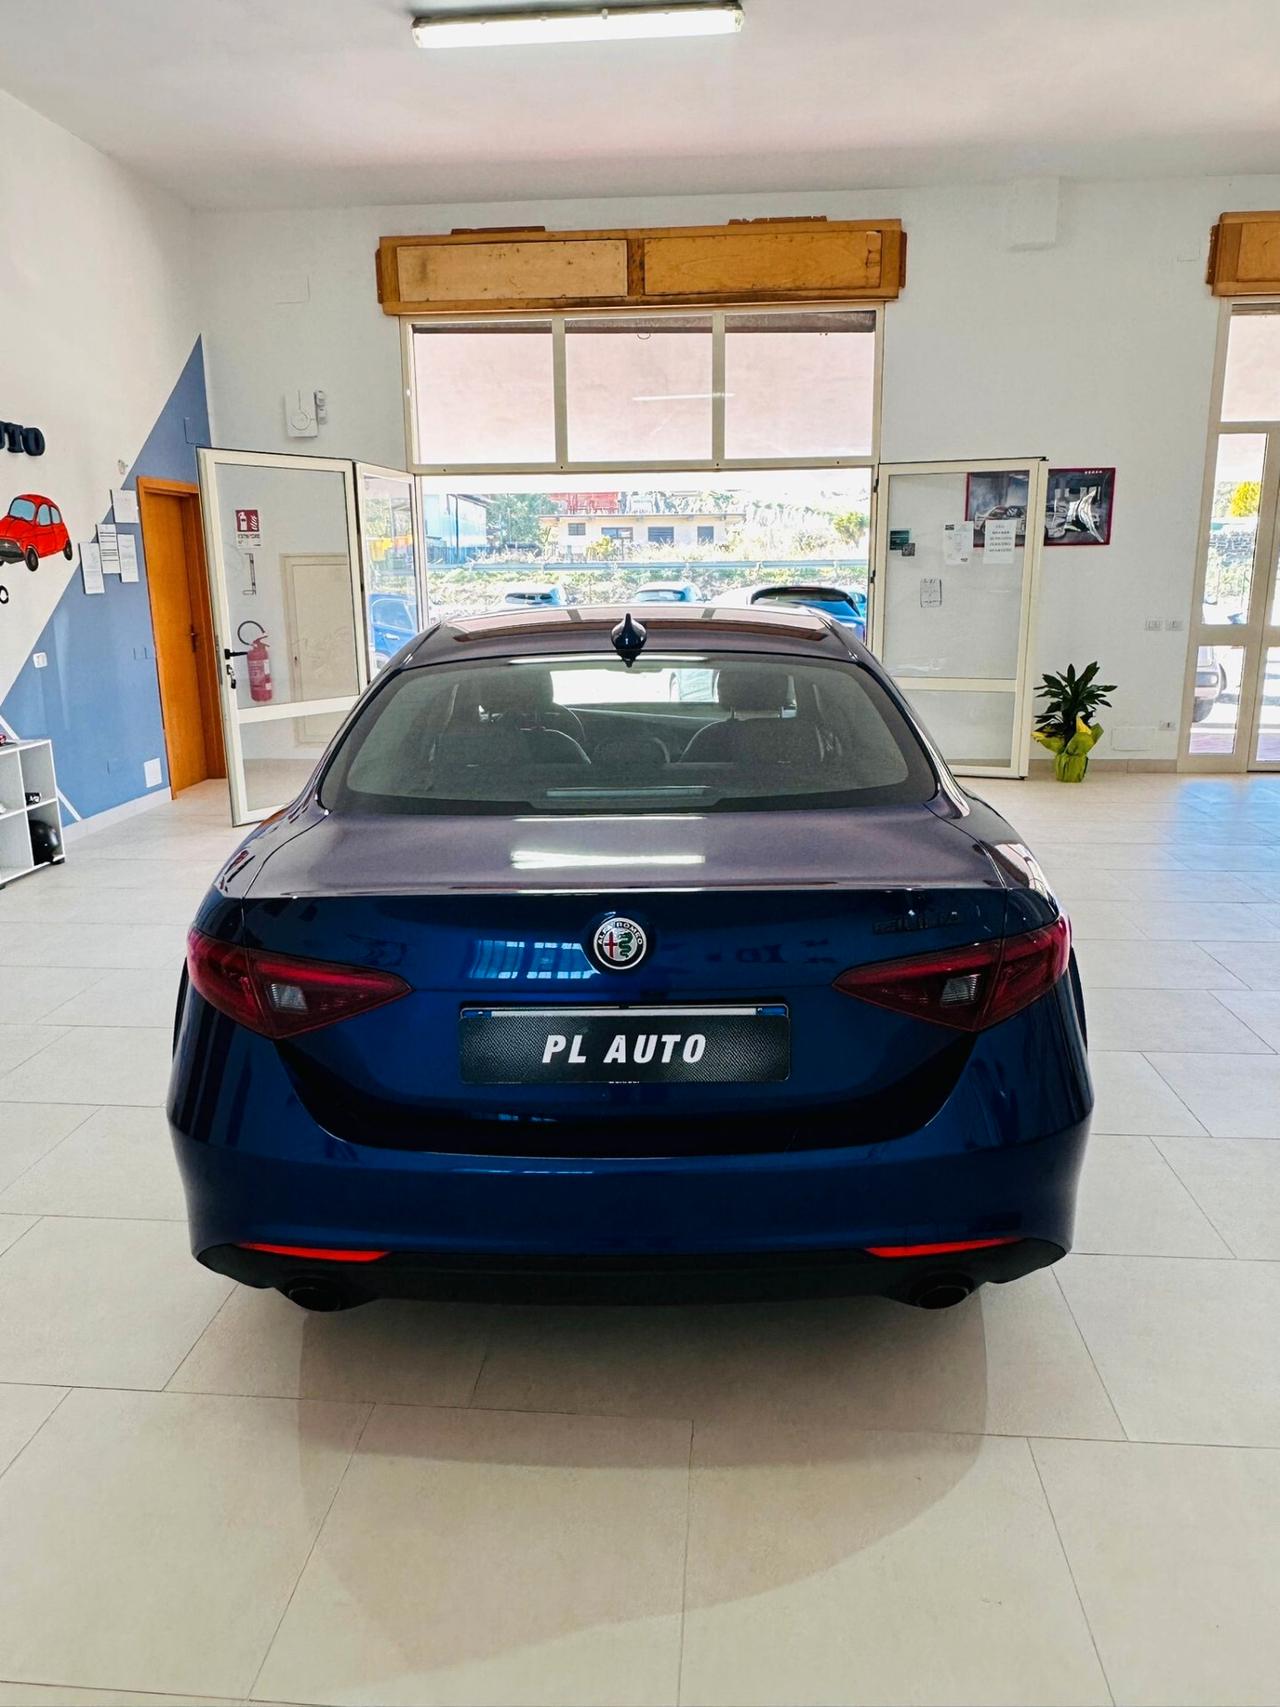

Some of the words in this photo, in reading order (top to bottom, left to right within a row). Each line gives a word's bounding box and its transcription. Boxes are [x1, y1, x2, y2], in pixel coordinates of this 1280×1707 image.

[616, 922, 643, 945] ROMEO
[542, 1034, 587, 1064] PL
[603, 1033, 707, 1064] AUTO
